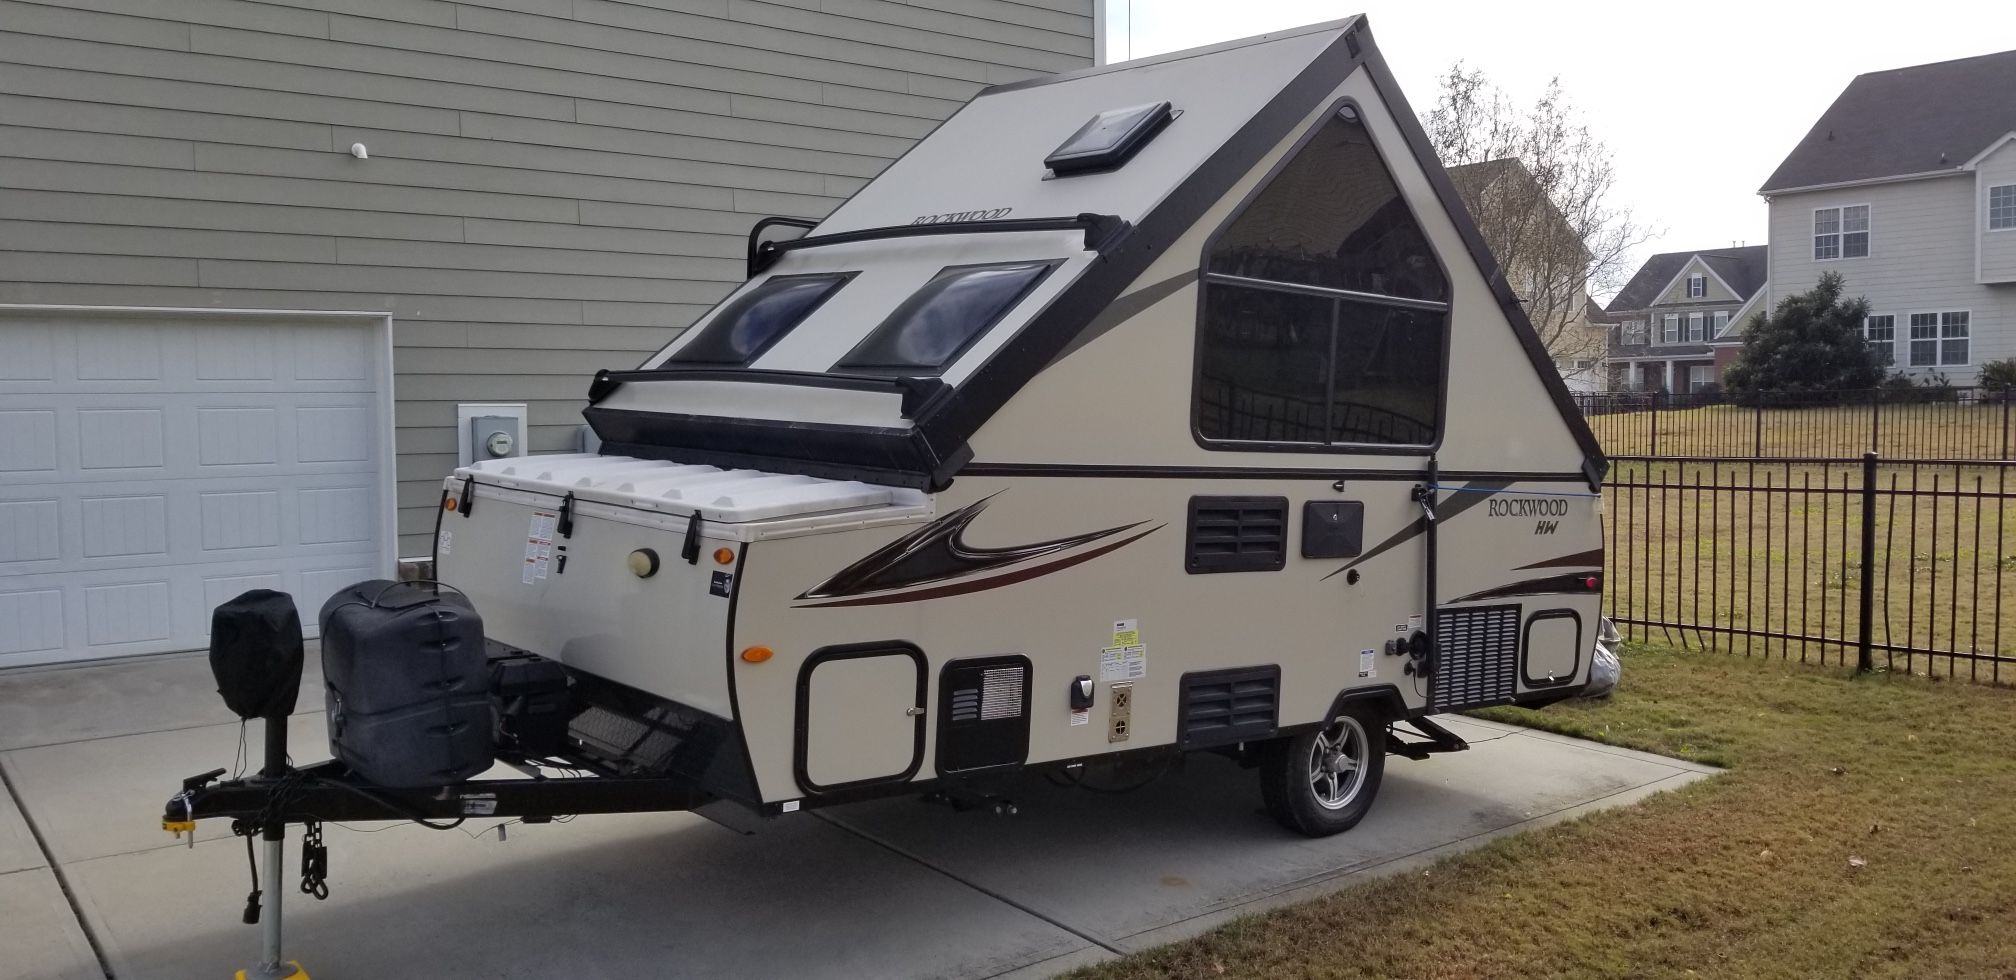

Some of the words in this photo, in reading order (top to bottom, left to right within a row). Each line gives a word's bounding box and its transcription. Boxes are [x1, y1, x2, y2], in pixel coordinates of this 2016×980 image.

[910, 207, 1013, 225] ROCKWOOD
[1488, 498, 1568, 517] ROCKWOOD
[1534, 520, 1559, 535] HW
